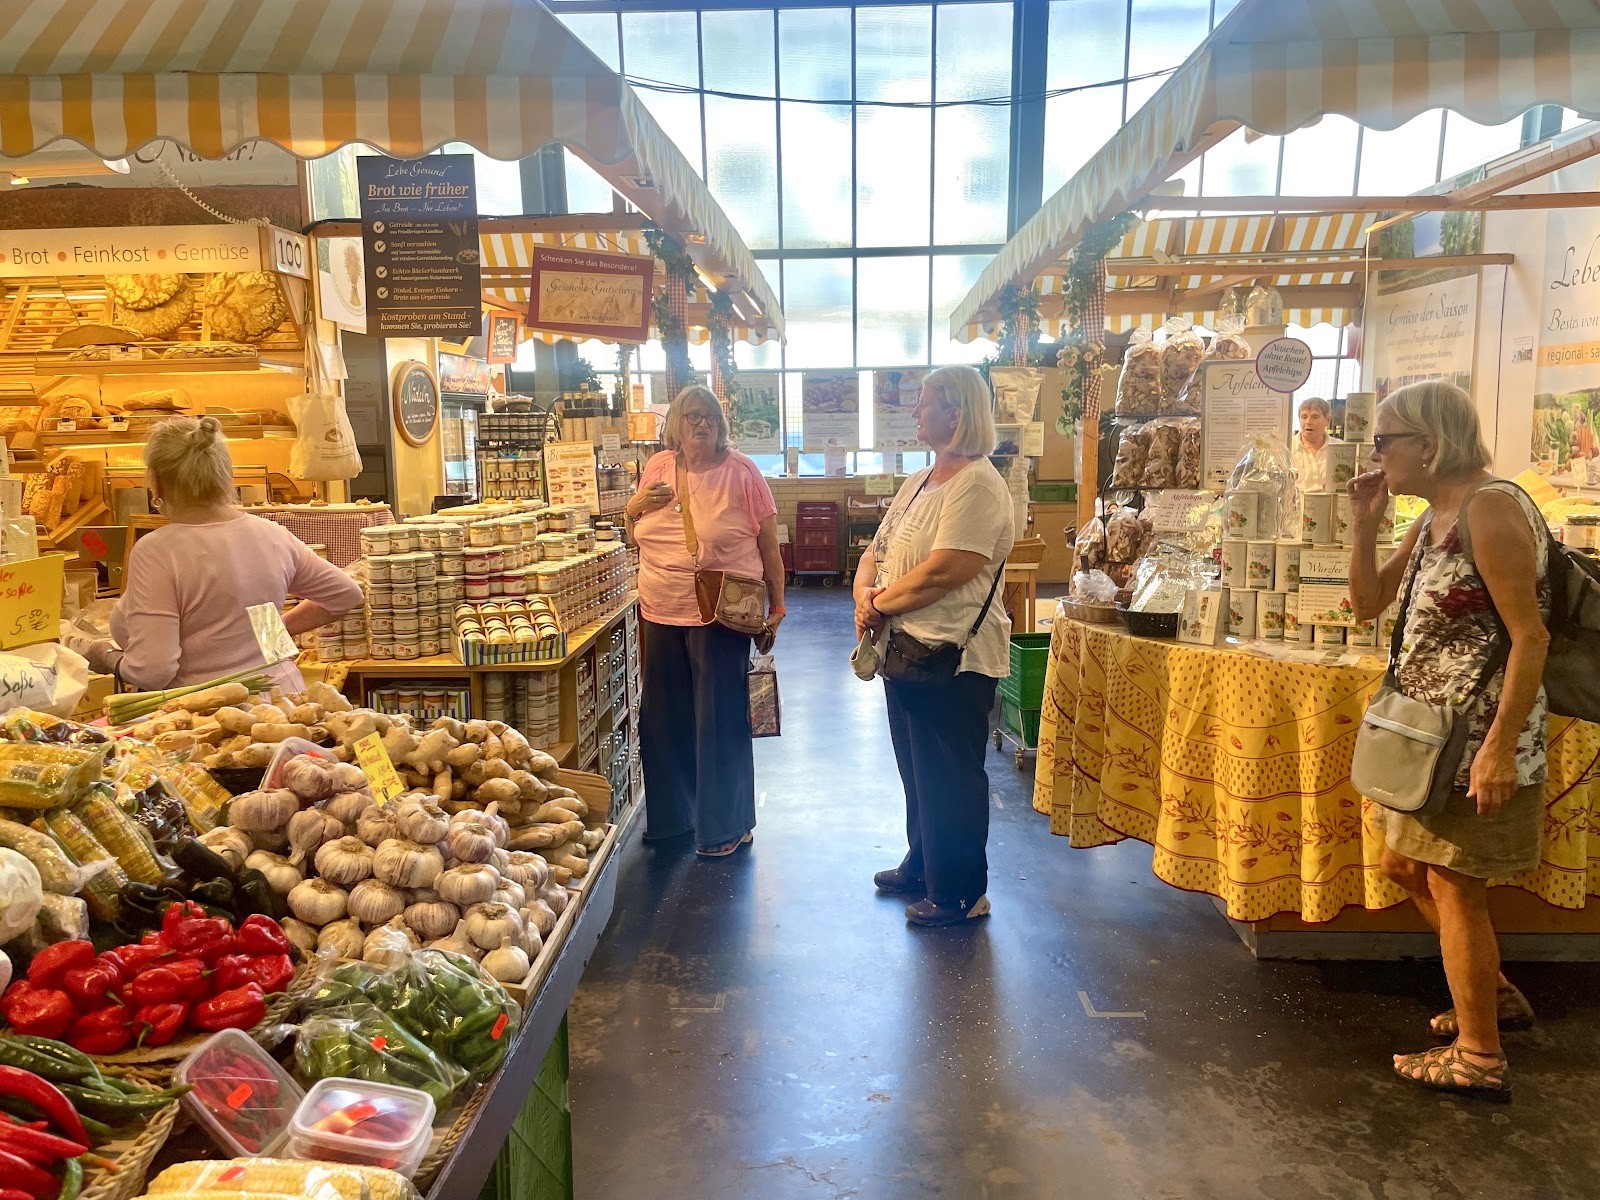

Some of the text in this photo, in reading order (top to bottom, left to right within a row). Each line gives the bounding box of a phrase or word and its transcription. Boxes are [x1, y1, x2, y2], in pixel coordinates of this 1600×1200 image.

[409, 162, 452, 177] Gesund
[368, 182, 469, 199] Brot wie früher
[392, 203, 409, 213] Brot
[389, 221, 414, 229] Getreide
[12, 243, 249, 265] Brot Feinkost Gemüse
[278, 238, 302, 269] 100
[540, 254, 573, 264] Schenken
[574, 258, 585, 266] Sie
[599, 260, 638, 271] Besondere!
[412, 267, 460, 275] Bäckerhandwerk
[381, 312, 426, 322] Kostproben
[442, 311, 466, 320] Stand
[1386, 292, 1469, 334] Gemüse der Saison
[1548, 309, 1599, 331] Bestes von
[380, 321, 472, 332] kommen Sie, probieren Sie!
[1271, 344, 1305, 355] Naschen
[1547, 347, 1584, 364] regional
[1264, 352, 1307, 364] ohne Reue!
[1263, 364, 1303, 377] Apfelchips
